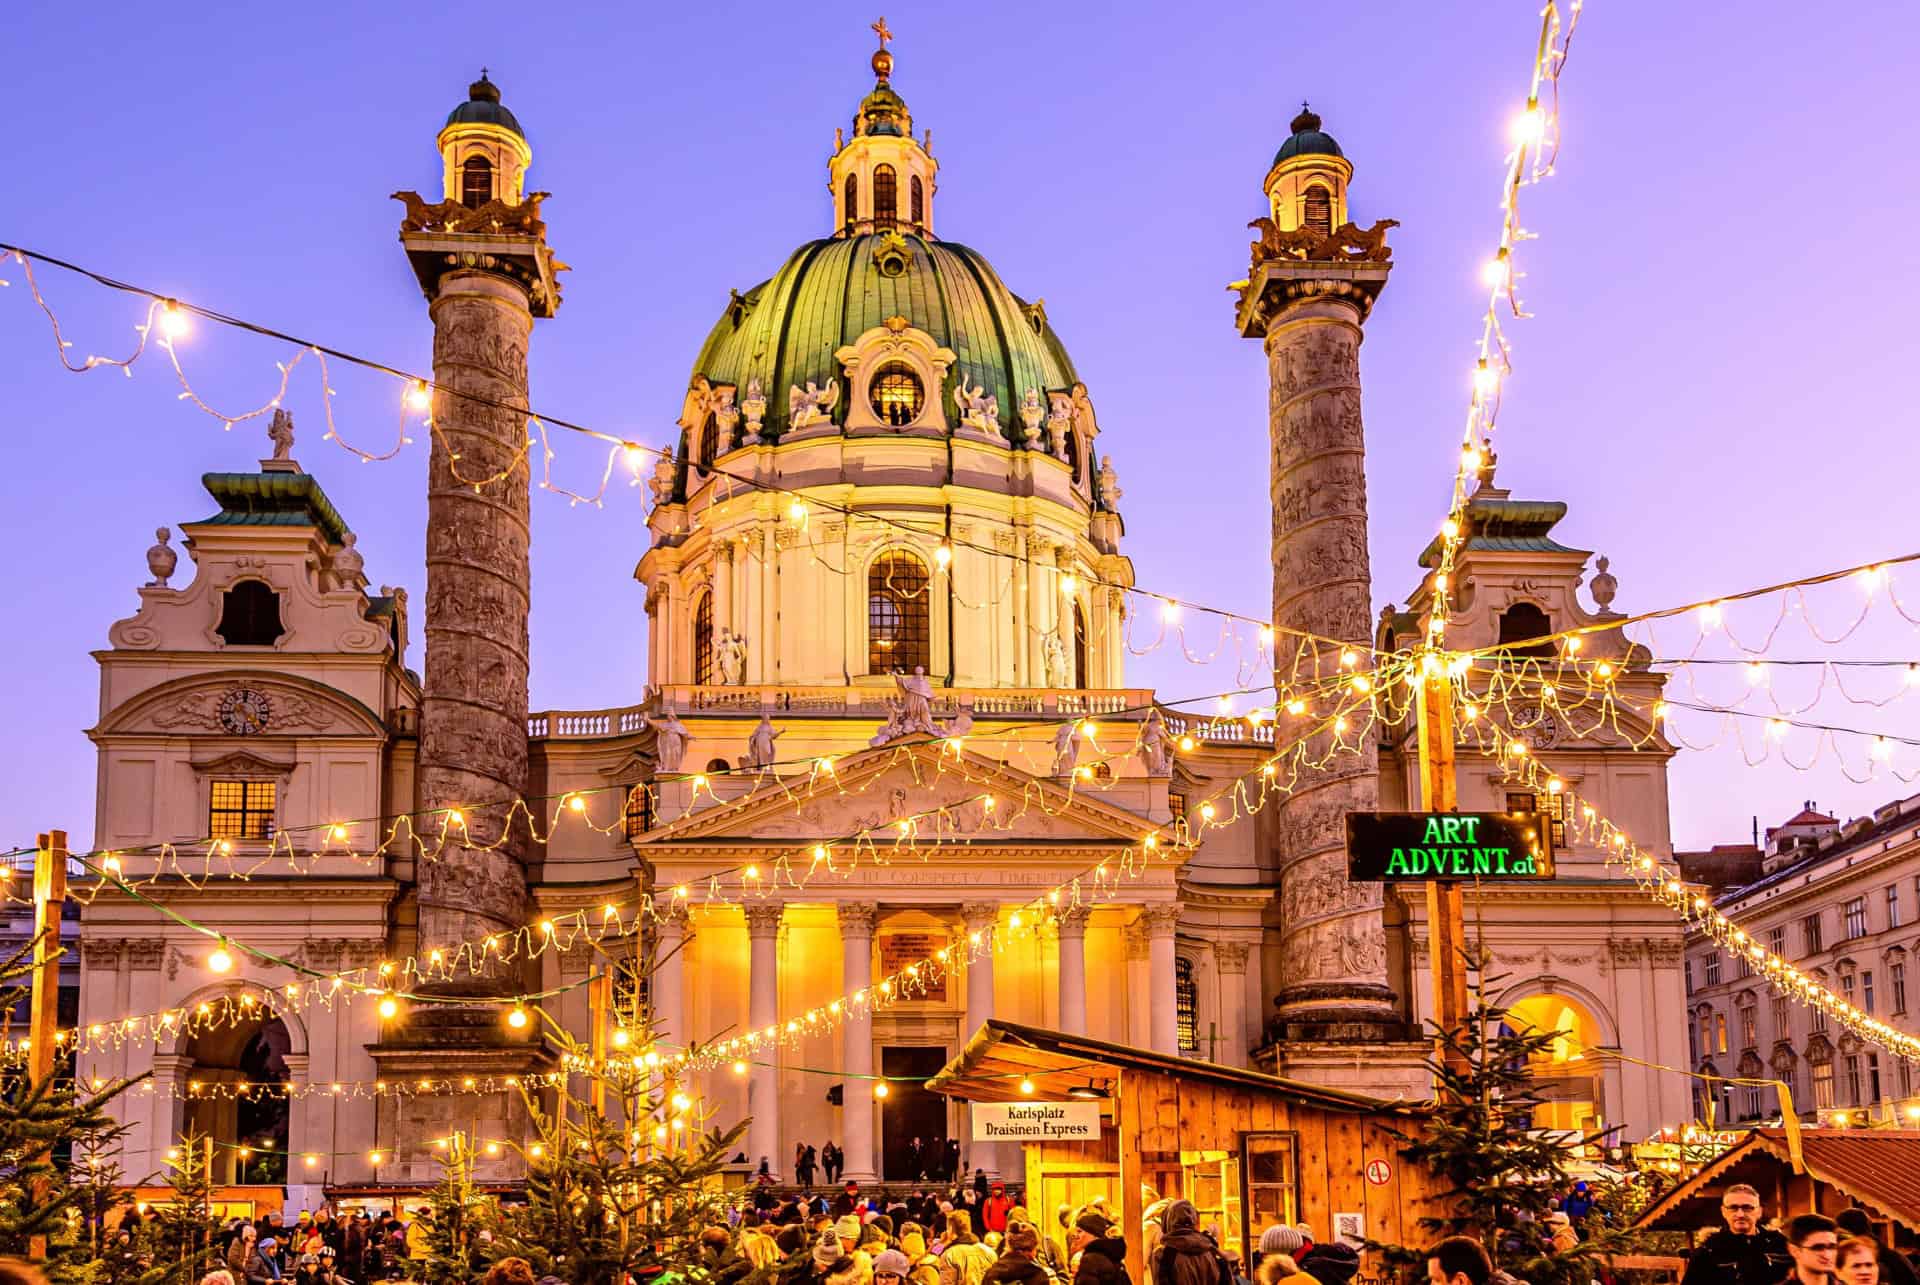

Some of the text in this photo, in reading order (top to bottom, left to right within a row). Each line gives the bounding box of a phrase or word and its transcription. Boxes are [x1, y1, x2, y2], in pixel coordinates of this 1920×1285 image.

[1421, 816, 1480, 844] ART
[1385, 847, 1536, 875] ADVENT.at
[1008, 1105, 1065, 1122] Karlsplatz
[985, 1121, 1088, 1138] Draisinen Express
